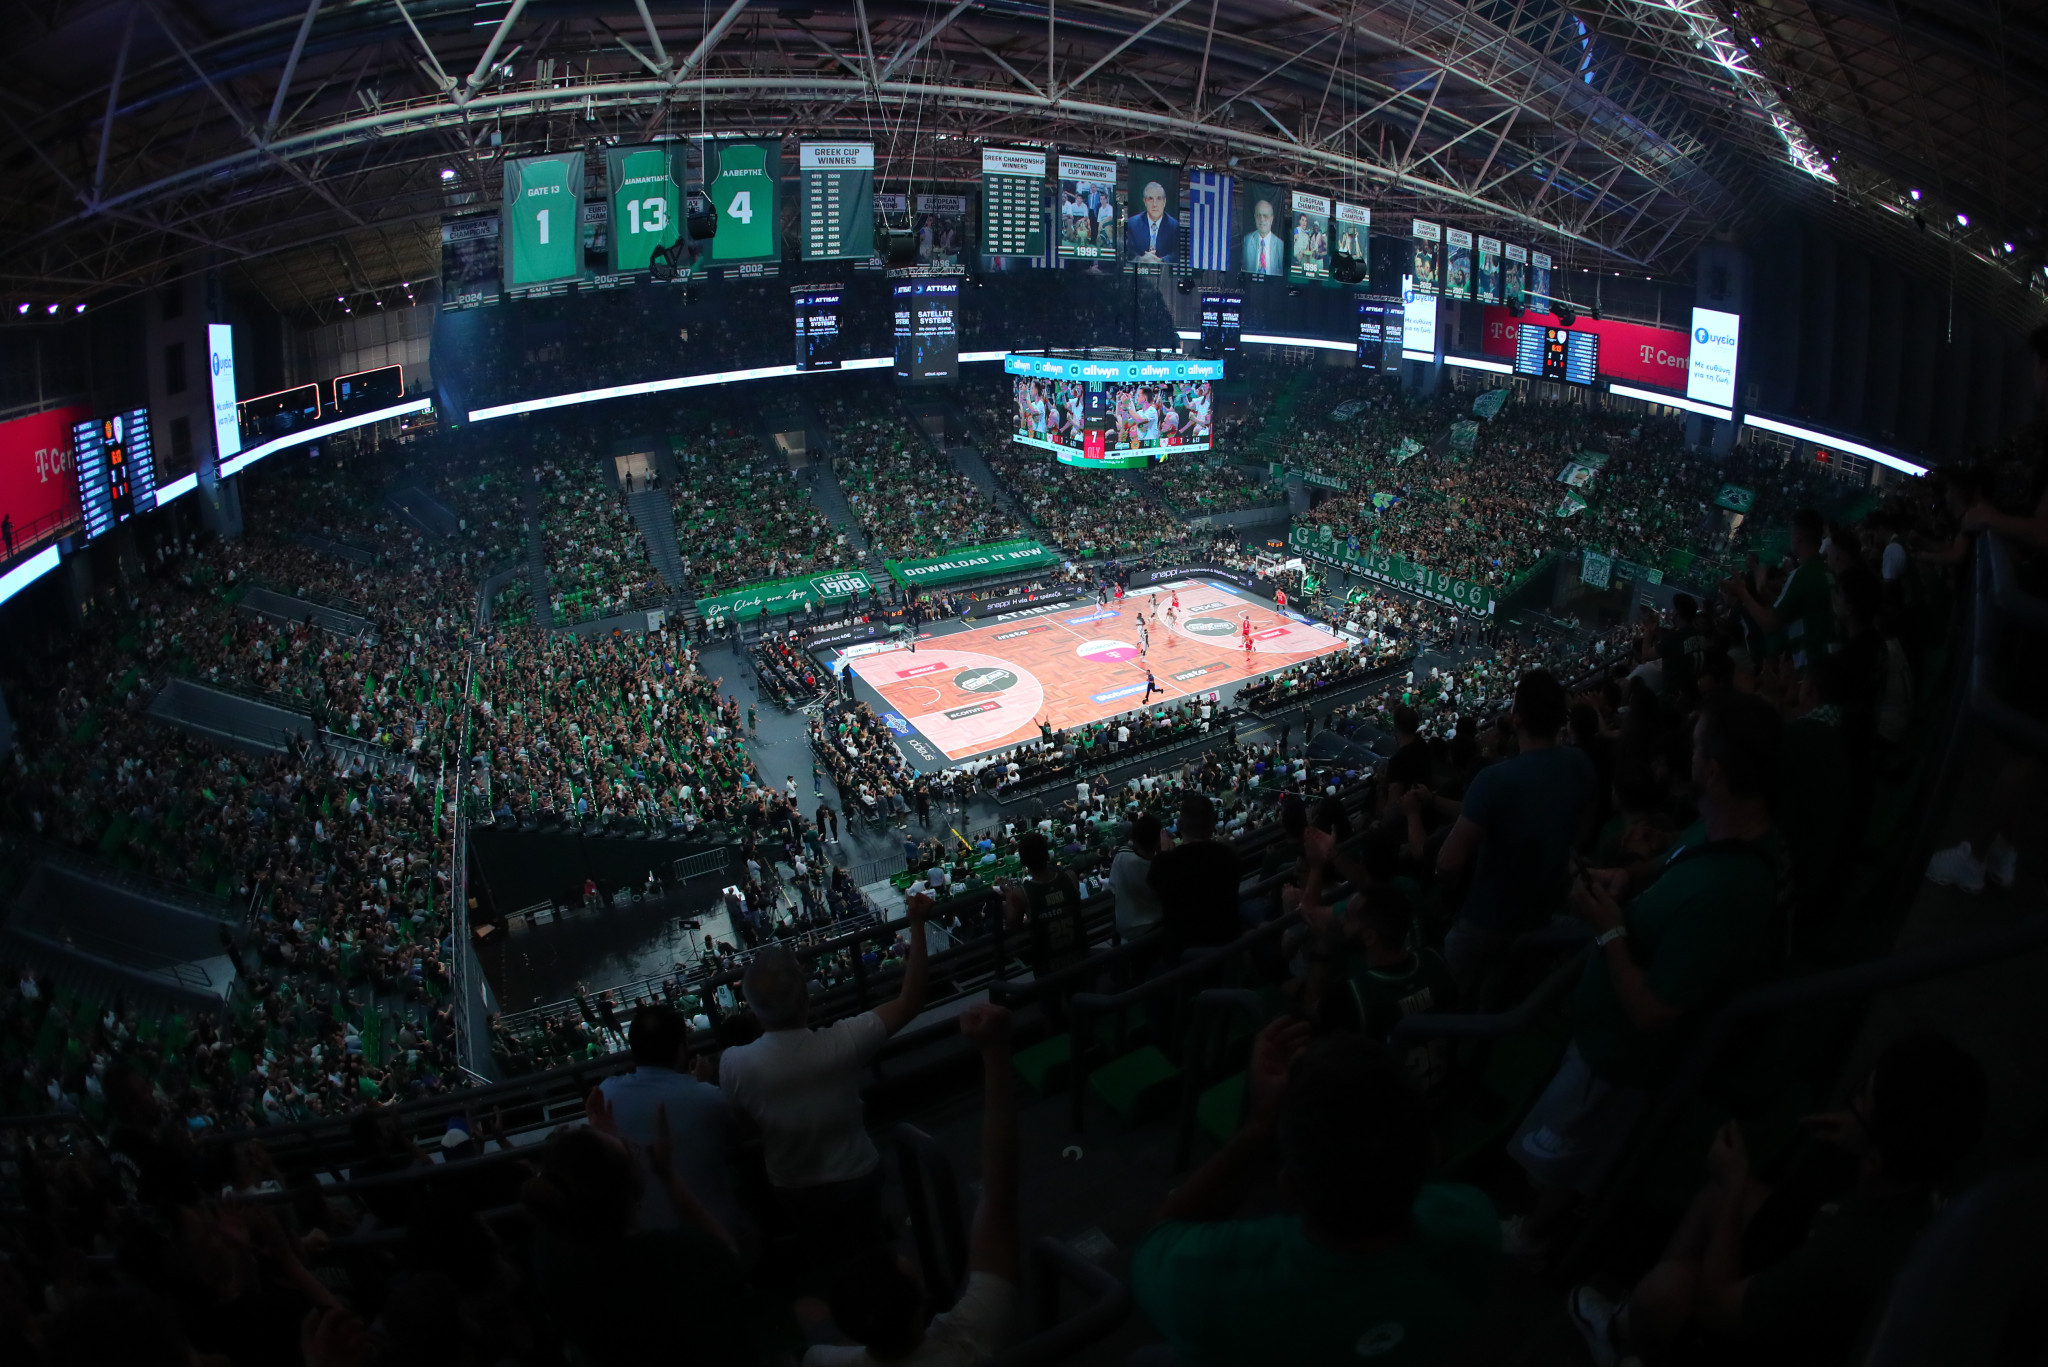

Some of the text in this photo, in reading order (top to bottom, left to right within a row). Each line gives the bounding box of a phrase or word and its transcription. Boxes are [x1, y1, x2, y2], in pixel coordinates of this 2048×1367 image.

[818, 157, 857, 165] WINNERS
[1002, 162, 1028, 170] WINNERS
[1003, 156, 1045, 165] CHAMPIONSHIP
[722, 169, 763, 177] ΑΛΒΕΡΤΗΣ
[1060, 162, 1114, 173] INTERCONTINENTAL
[624, 175, 669, 185] ΔΙΑΜΑΝΤΙΔΗΣ
[1081, 170, 1107, 178] WINNERS
[527, 185, 560, 197] GATE 13
[1299, 196, 1324, 207] EUROPEAN
[588, 205, 607, 214] EURO
[727, 191, 753, 225] 4
[1298, 203, 1325, 213] CHAMPIONS
[1342, 207, 1364, 216] EUROPEAN
[627, 197, 667, 234] 13
[1341, 213, 1366, 222] CHAMPIONS
[452, 221, 488, 231] EUROPEAN
[536, 209, 549, 244] 1
[449, 227, 491, 239] CHAMPIONS
[1077, 247, 1098, 257] 1996
[740, 264, 763, 274] 2002
[1304, 262, 1317, 272] 1996
[459, 293, 483, 304] 2024
[918, 310, 953, 318] SATELLITE
[1709, 333, 1735, 346] υγεία
[1013, 360, 1031, 371] allwyn
[1656, 350, 1690, 370] Cent
[1042, 362, 1063, 375] allwyn
[1083, 364, 1119, 378] allwyn
[1141, 365, 1170, 378] allwyn
[1187, 364, 1213, 377] allwyn
[1092, 396, 1099, 409] 2
[1091, 432, 1098, 443] 7
[1087, 446, 1101, 459] OLY
[1303, 471, 1348, 489] PATISSIA
[903, 557, 989, 577] DOWNLOAD
[1008, 547, 1042, 559] NOW
[823, 574, 850, 582] CLUB
[1151, 568, 1178, 581] snappi
[820, 577, 865, 594] 1908
[1427, 570, 1481, 604] 1966
[708, 604, 730, 616] One
[734, 596, 763, 612] Club
[785, 589, 807, 600] App
[987, 599, 1010, 610] snappi
[997, 602, 1070, 621] ATHENS
[996, 626, 1048, 640] instacar
[1175, 664, 1226, 680] instacar
[950, 702, 997, 719] ecommbx
